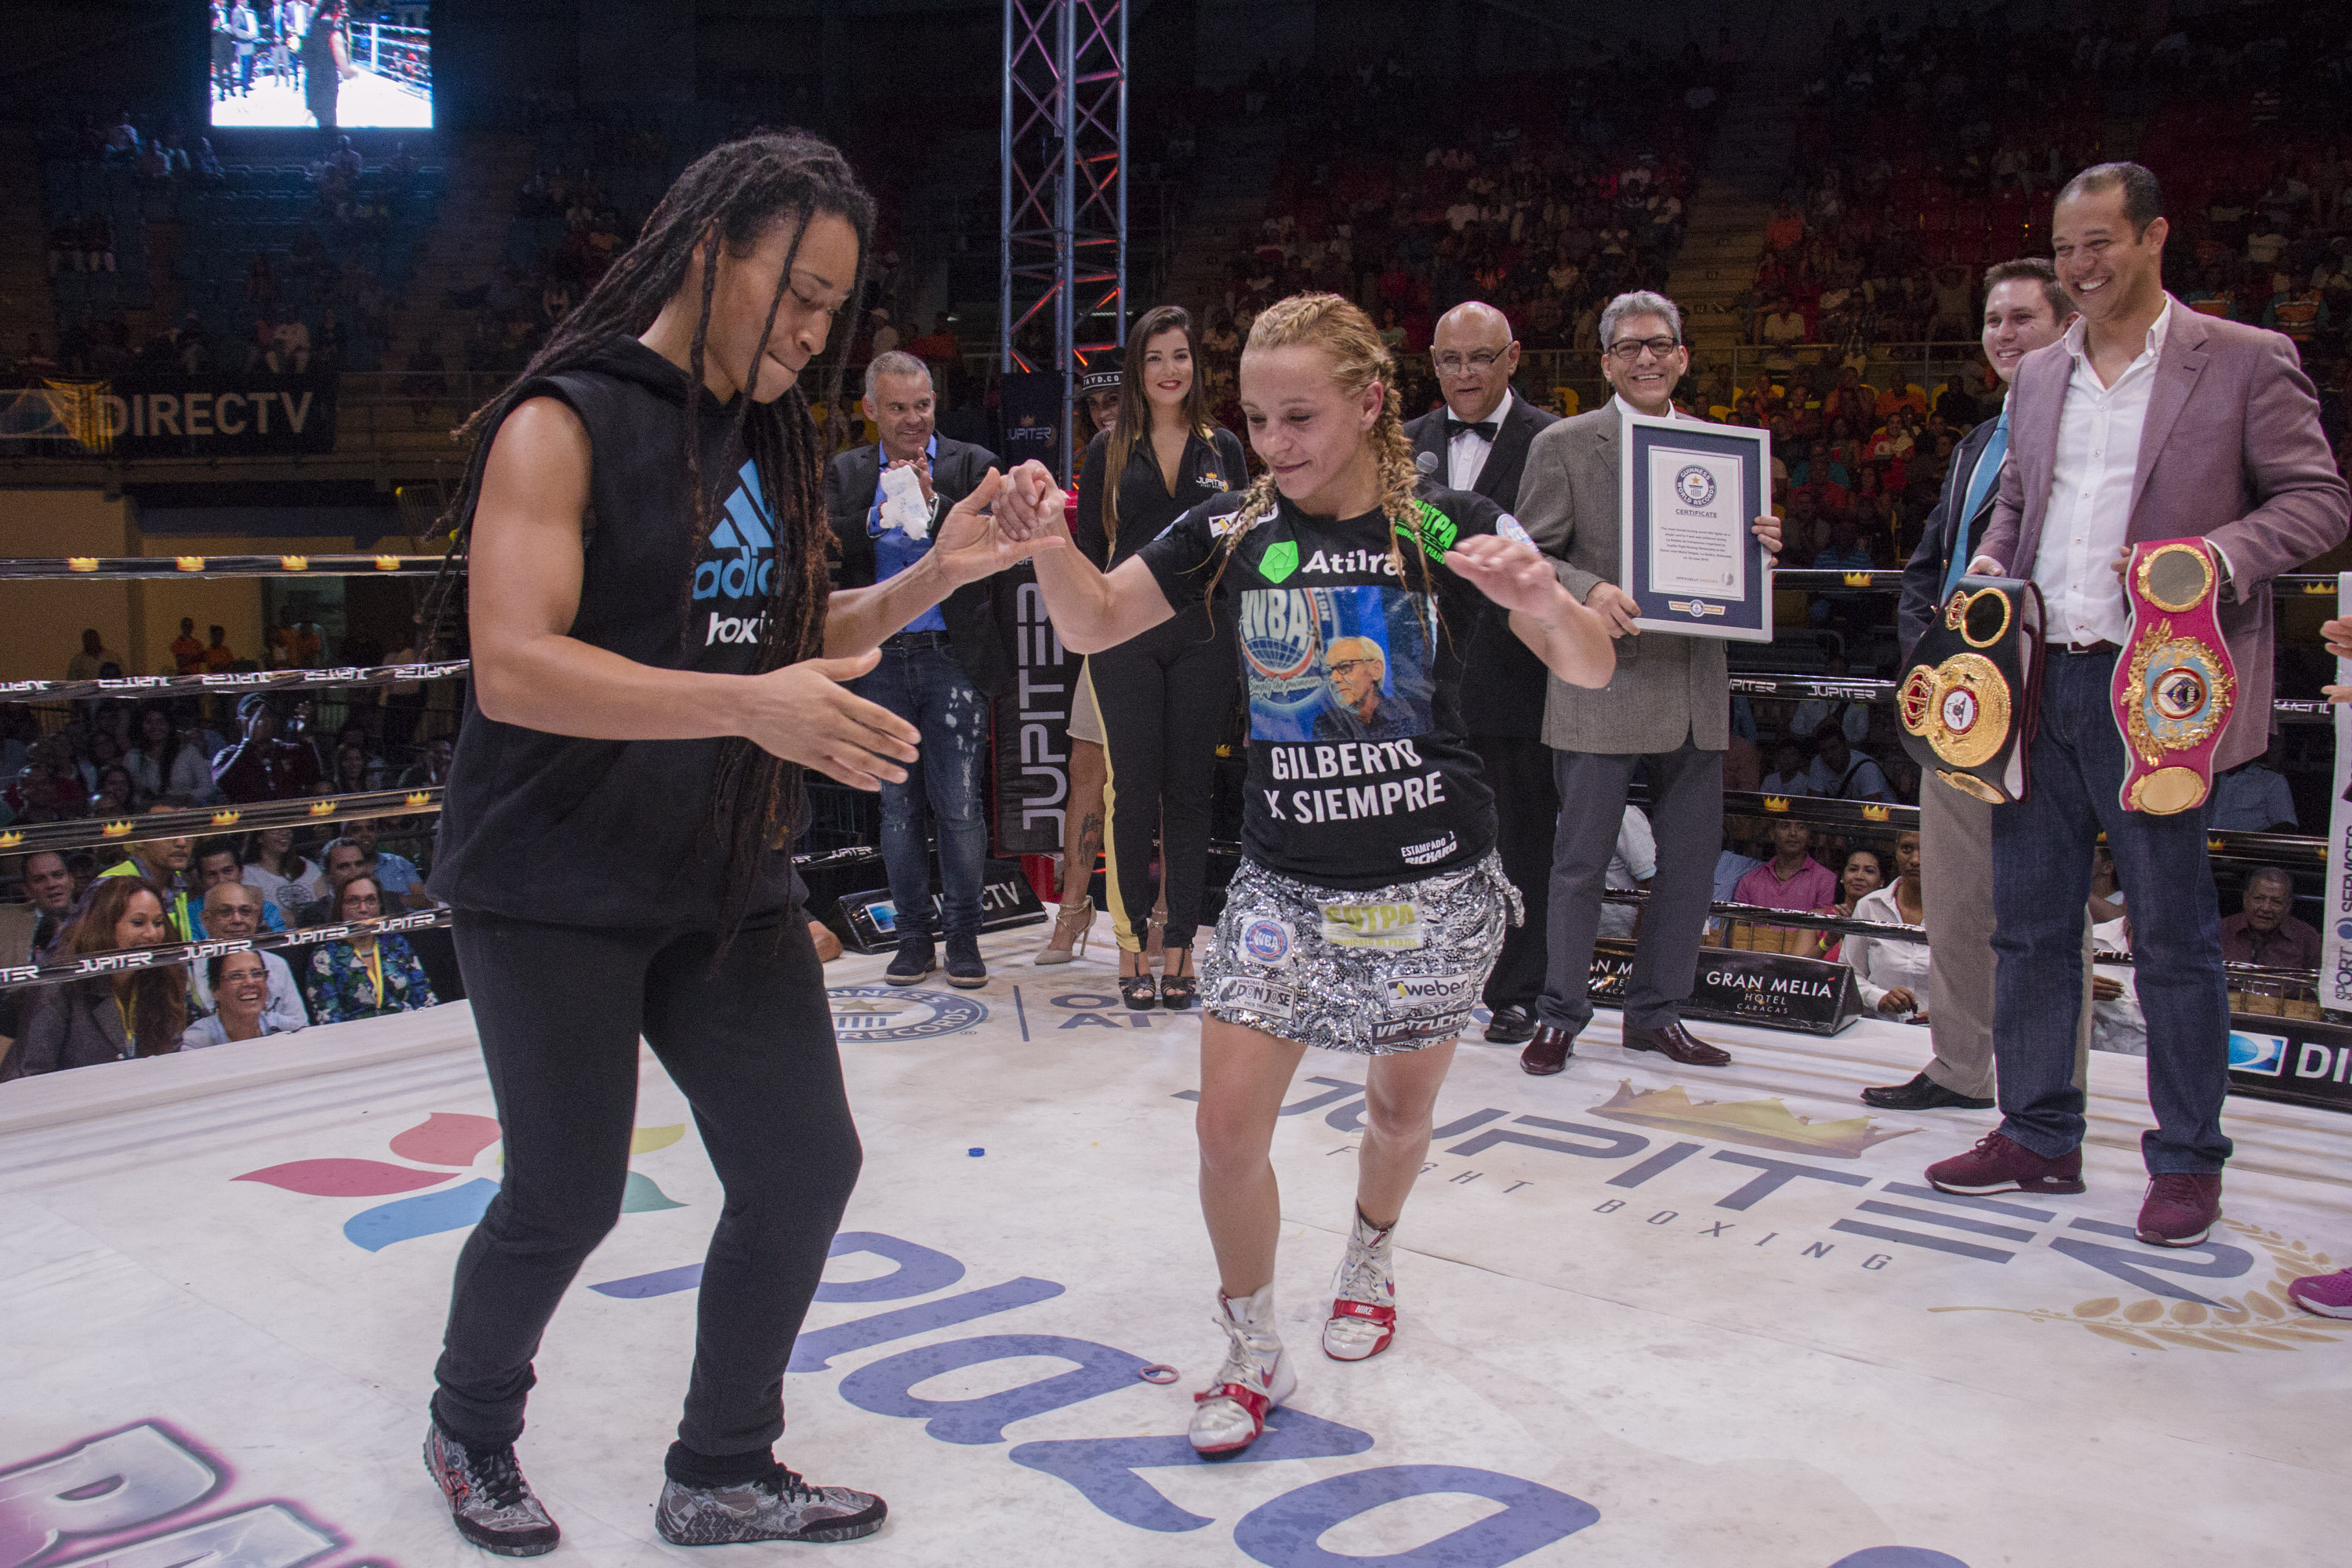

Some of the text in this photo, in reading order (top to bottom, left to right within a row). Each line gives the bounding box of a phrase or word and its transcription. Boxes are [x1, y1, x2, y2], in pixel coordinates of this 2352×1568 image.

[100, 392, 313, 437] DIRECTV
[1196, 476, 1226, 487] JUPITER
[1680, 468, 1711, 481] GUINNESS
[1677, 481, 1715, 506] WORLD RECORDS
[1675, 509, 1717, 518] CERTIFICATE
[1301, 549, 1406, 576] Atilra
[1242, 589, 1308, 651] WBA
[201, 671, 272, 686] JUPITER
[304, 667, 371, 681] JUPITER
[394, 666, 459, 679] JUPITER
[98, 677, 172, 689] JUPITER
[1807, 685, 1877, 699] JUPITER
[2187, 686, 2195, 703] WBO
[1017, 582, 1067, 848] JUPITER
[1271, 739, 1422, 780] GILBERTO
[1264, 771, 1446, 824] X SIEMPRE
[829, 846, 873, 859] JUPITER
[1401, 837, 1446, 857] ESTAMPADO
[371, 913, 436, 934] JUPITER
[280, 927, 350, 946] JUPITER
[1254, 931, 1279, 950] WBA
[179, 939, 252, 961] JUPITER
[75, 952, 154, 974] JUPITER
[1706, 971, 1764, 990] GRAN
[2336, 946, 2352, 1002] SPORT
[1237, 984, 1291, 1007] DON JOSE
[1404, 979, 1468, 996] weber
[1737, 1003, 1788, 1014] CARACAS
[1744, 993, 1786, 1005] HOTEL
[839, 1007, 971, 1040] RECORDS
[1169, 1076, 2255, 1311] JUPITER
[1325, 1146, 1892, 1271] FGHT BOXING
[1355, 1305, 1374, 1316] NIKE
